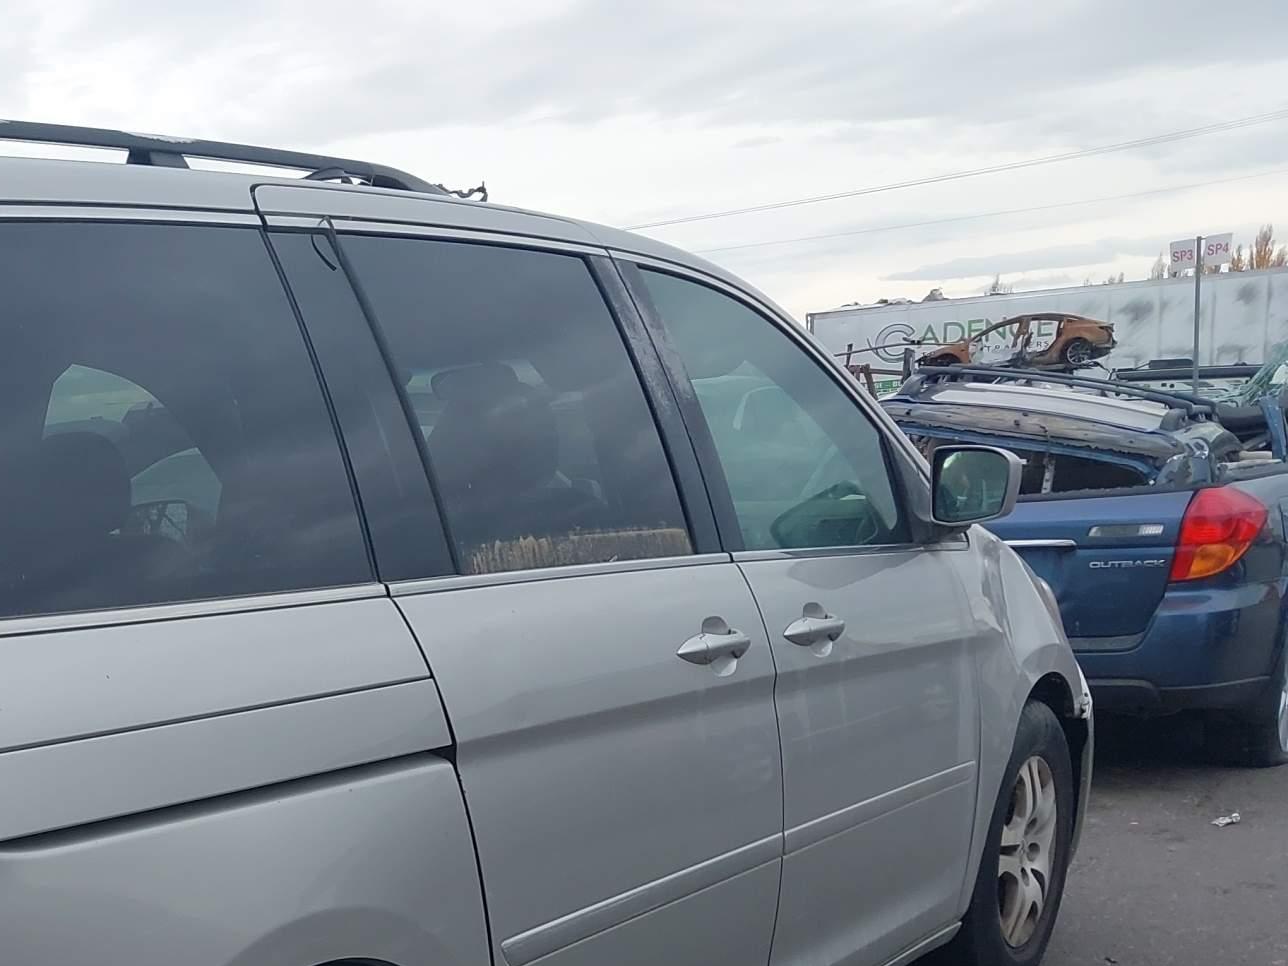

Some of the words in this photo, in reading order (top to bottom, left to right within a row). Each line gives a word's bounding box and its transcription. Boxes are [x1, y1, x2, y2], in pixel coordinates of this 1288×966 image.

[1172, 249, 1194, 263] SP3
[1207, 242, 1230, 256] SP4
[1088, 559, 1166, 569] OUTBACK
